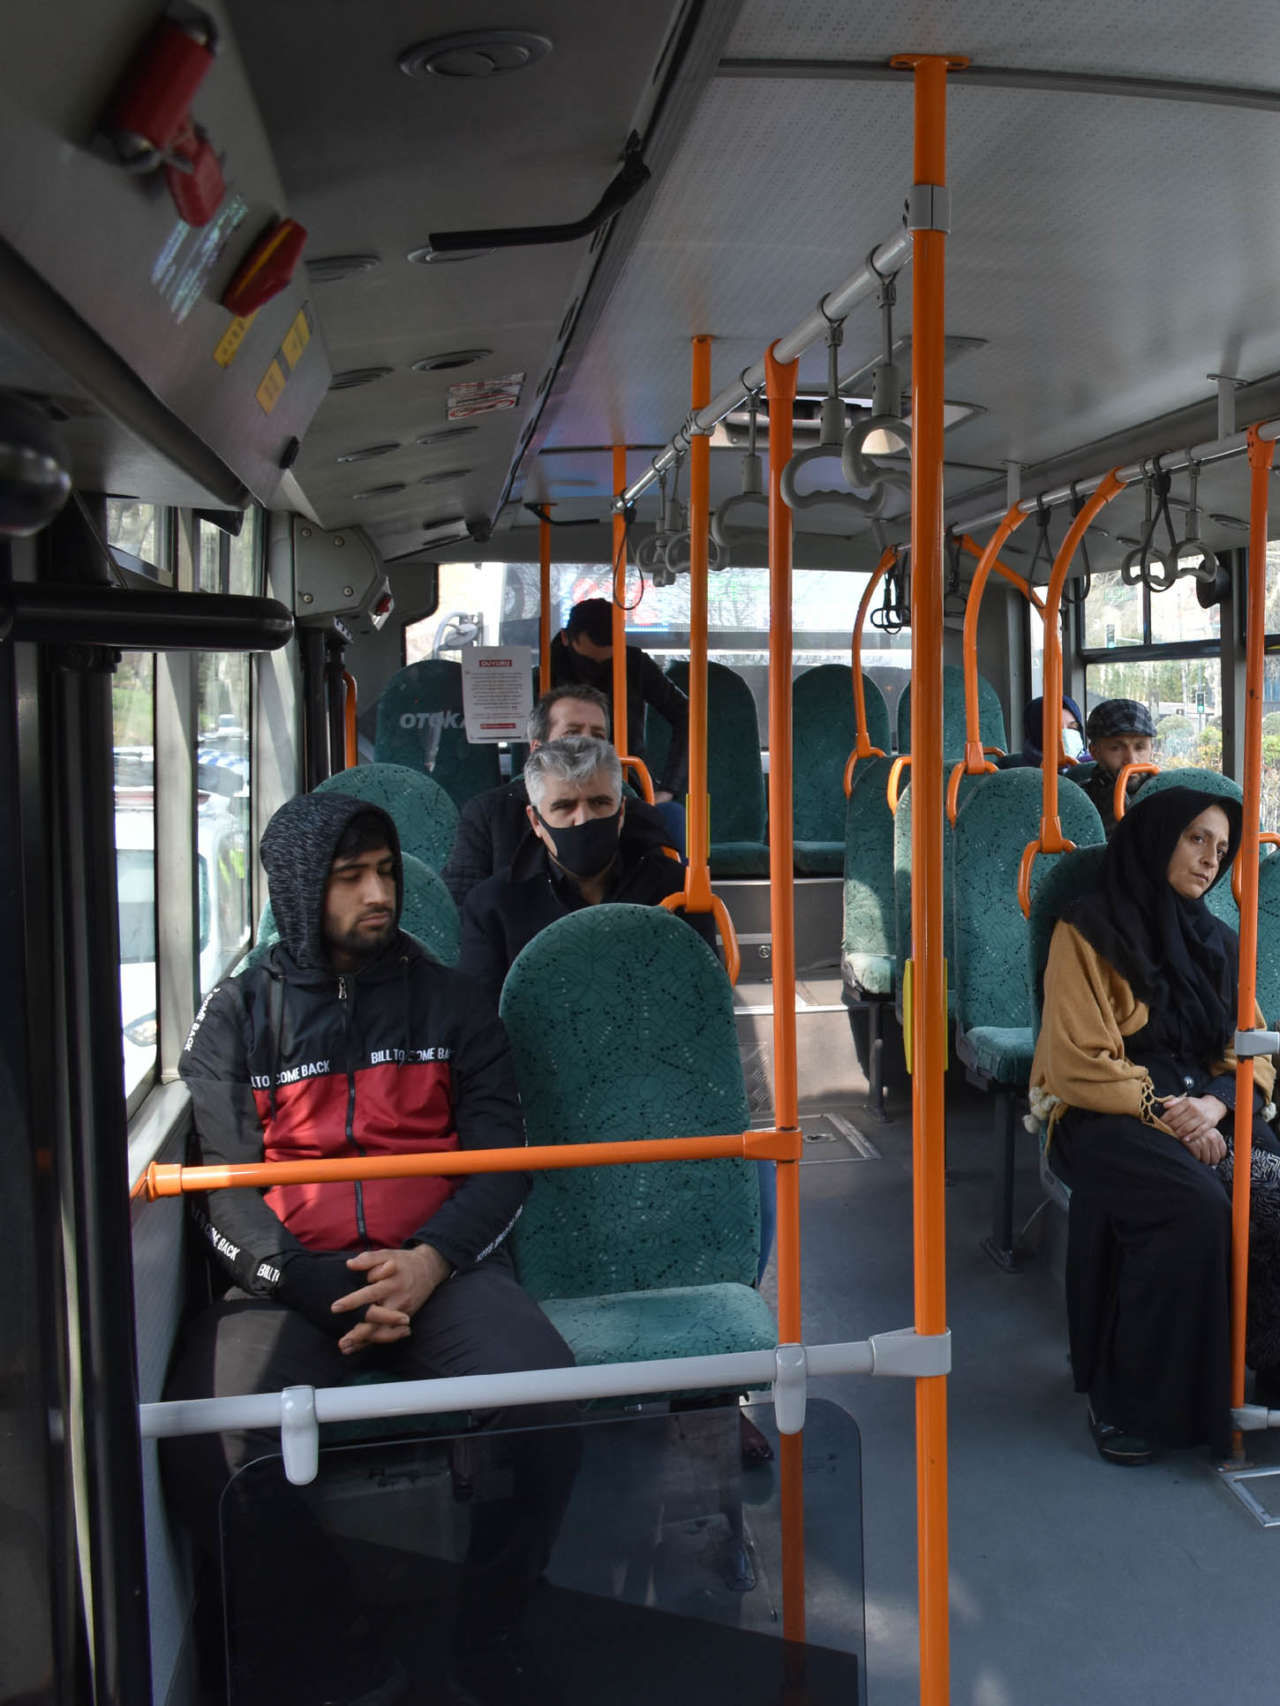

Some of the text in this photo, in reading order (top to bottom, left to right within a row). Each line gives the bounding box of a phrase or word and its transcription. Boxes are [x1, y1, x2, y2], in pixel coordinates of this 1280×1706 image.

[371, 1049, 392, 1064] BILL
[255, 1075, 270, 1088] TO
[301, 1060, 330, 1077] BACK
[217, 1238, 240, 1261] BACK
[257, 1264, 273, 1280] BILL
